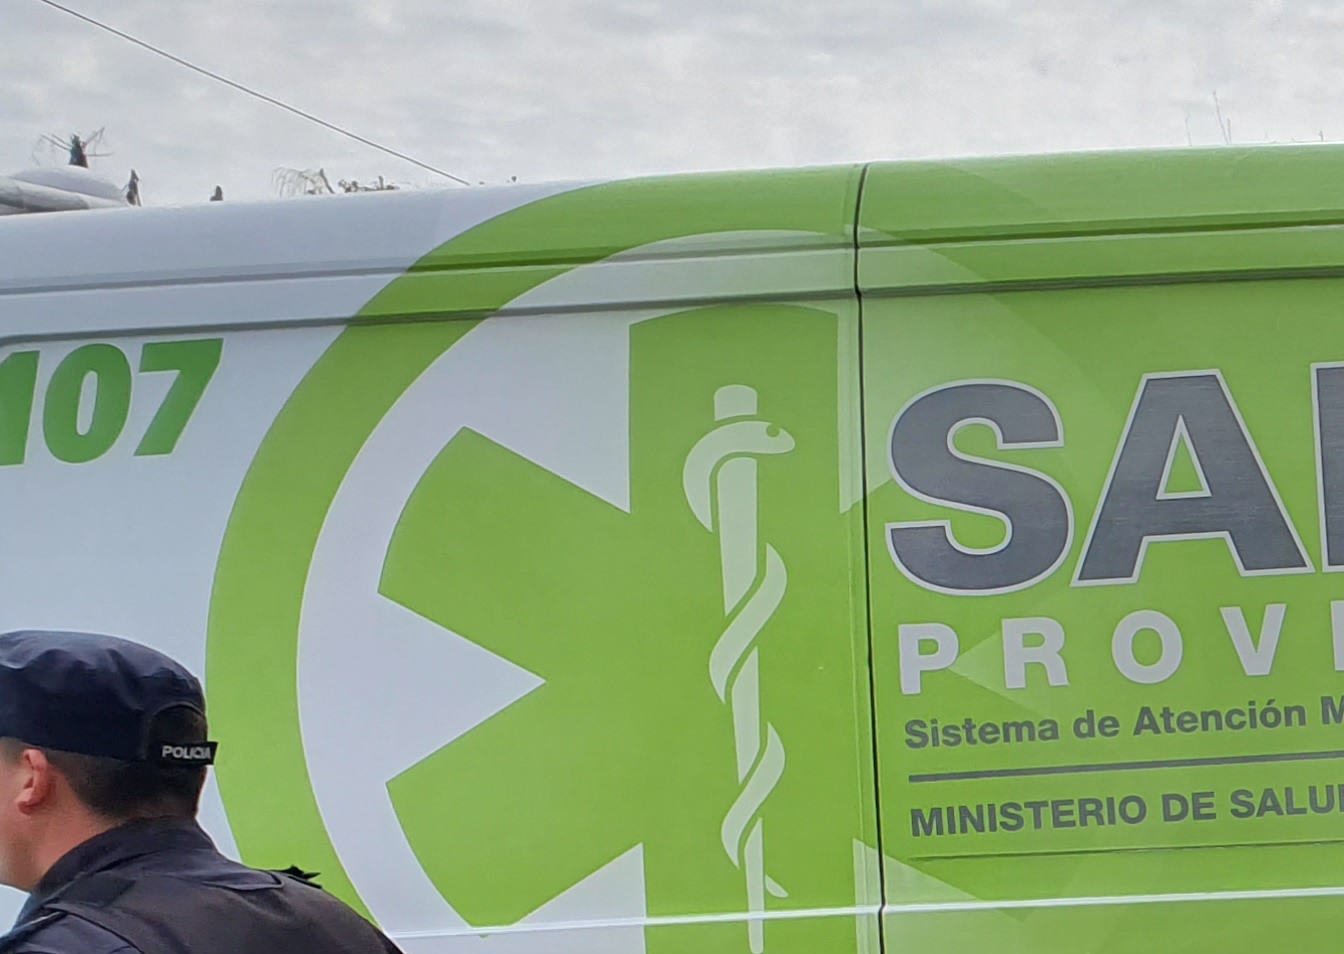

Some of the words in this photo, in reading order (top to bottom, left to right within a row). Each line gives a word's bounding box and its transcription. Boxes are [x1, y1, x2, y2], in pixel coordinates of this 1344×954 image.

[0, 338, 224, 466] 107
[904, 717, 1060, 749] Sistema
[1073, 710, 1120, 739] de
[1133, 699, 1307, 736] Atención
[162, 745, 212, 760] POLICIA
[910, 795, 1147, 837] MINISTERIO
[1161, 791, 1217, 822] DE
